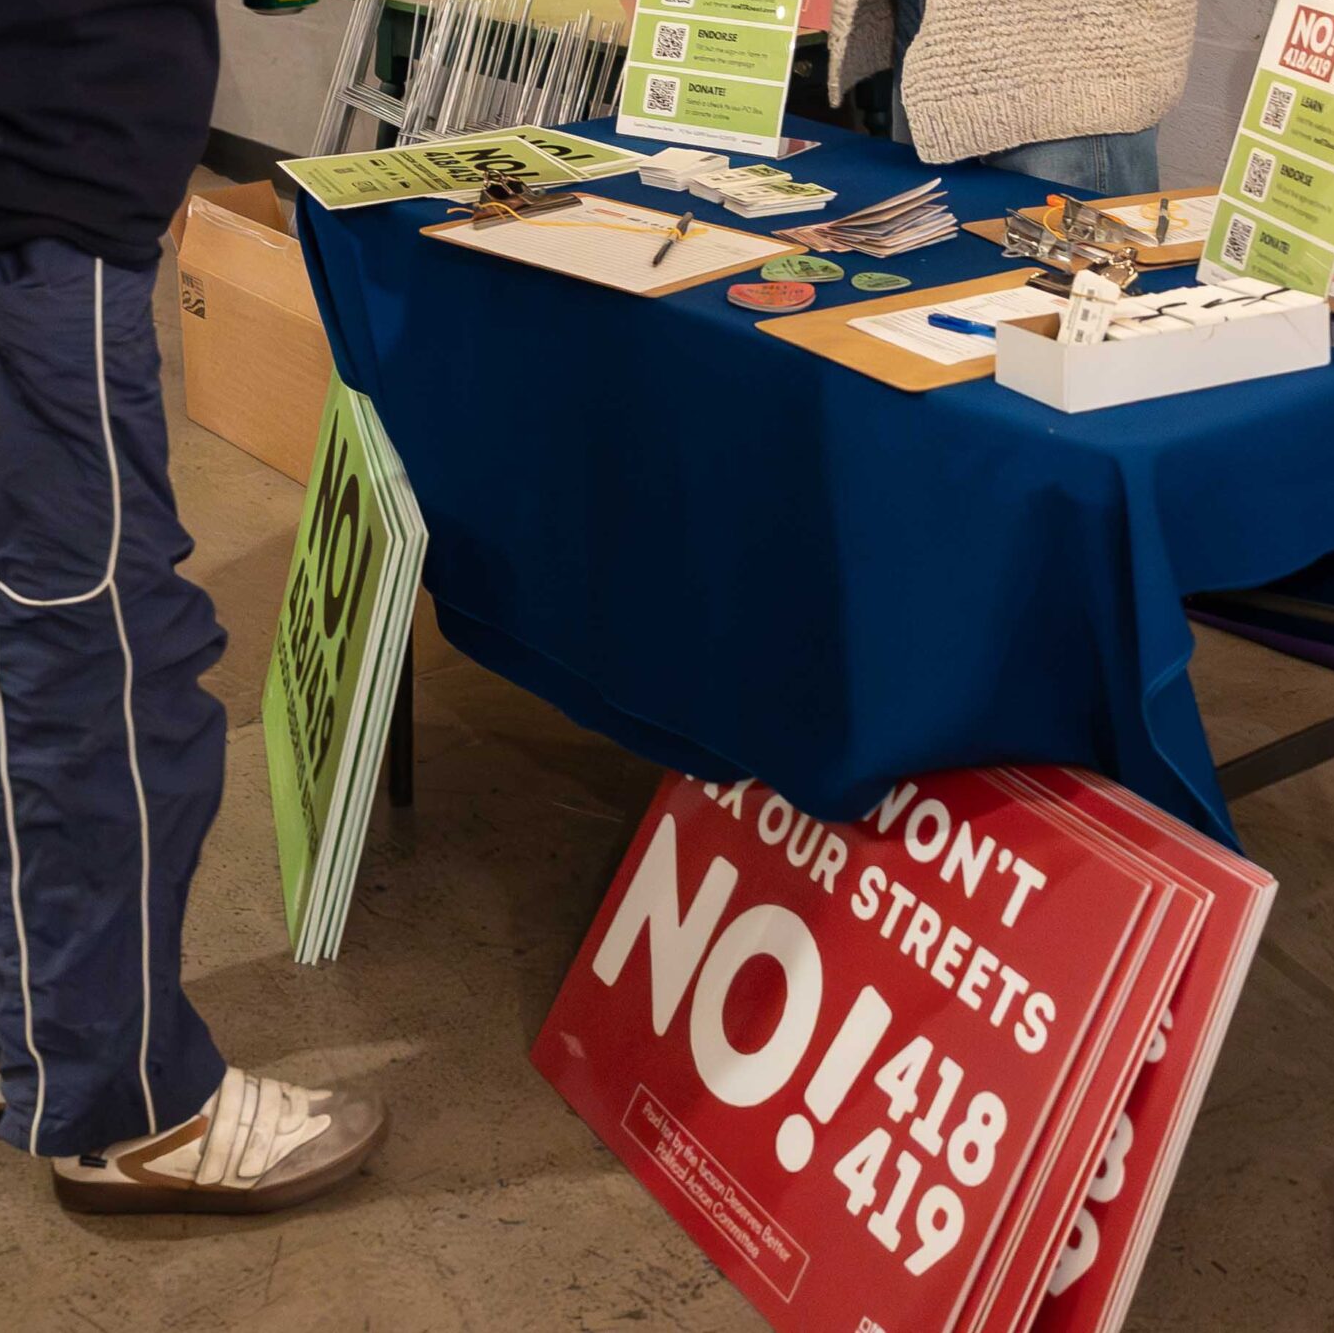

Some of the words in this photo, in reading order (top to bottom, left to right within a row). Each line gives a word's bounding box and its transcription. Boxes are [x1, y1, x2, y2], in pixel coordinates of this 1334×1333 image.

[697, 29, 738, 43] ENDORSE
[1282, 47, 1332, 78] 418/419
[308, 408, 373, 681] NO!
[287, 557, 335, 783] 418/419
[592, 812, 893, 1173] NO!
[757, 795, 848, 895] OUR
[850, 865, 1057, 1054] STREETS
[641, 1101, 662, 1129] Paid
[672, 1131, 684, 1155] by
[697, 1158, 726, 1197] Tucson
[724, 1185, 763, 1236] Deserves
[760, 1224, 792, 1263] Better
[873, 1034, 1008, 1188] 418
[654, 1141, 689, 1182] Political
[684, 1173, 714, 1209] Action
[712, 1201, 760, 1259] Committee
[832, 1126, 966, 1277] 419
